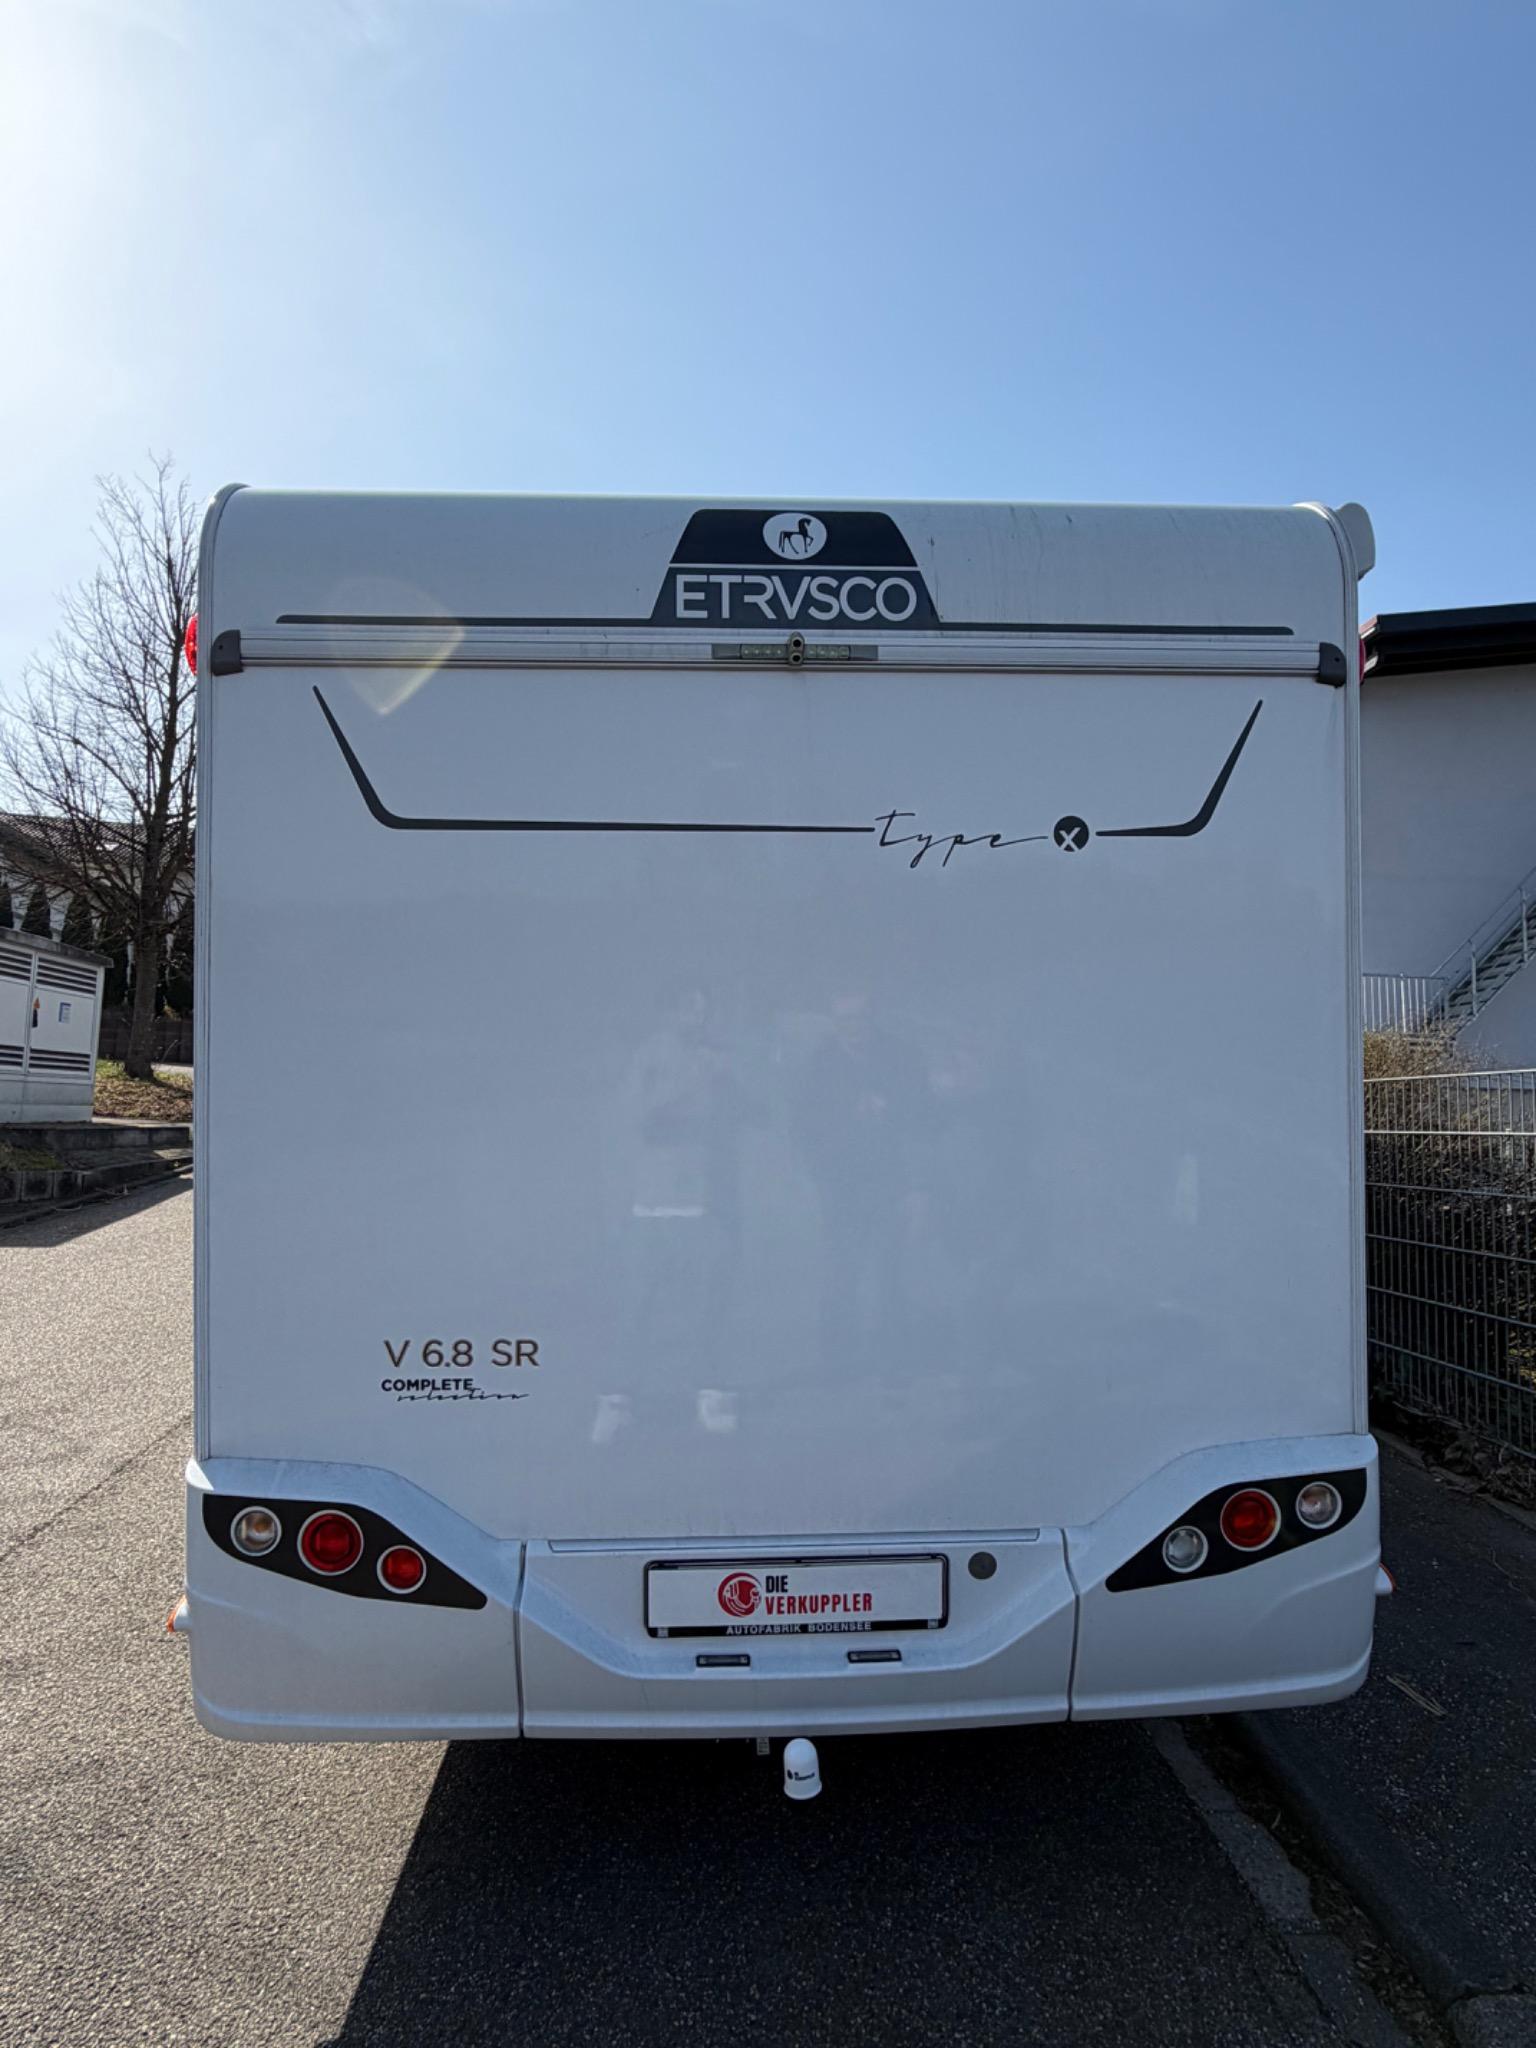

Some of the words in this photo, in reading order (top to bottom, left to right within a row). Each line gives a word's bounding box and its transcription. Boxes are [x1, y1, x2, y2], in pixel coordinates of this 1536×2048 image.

[675, 573, 918, 622] ETRVSCO
[874, 809, 1048, 869] type
[383, 1339, 411, 1368] V
[422, 1339, 474, 1368] 6.8
[491, 1338, 540, 1368] SR
[381, 1378, 474, 1392] COMPLETE
[765, 1575, 788, 1594] DIE
[764, 1593, 873, 1616] VERKUPPLER
[725, 1623, 802, 1636] AUTOFABRIK
[807, 1621, 872, 1633] BODENSEE
